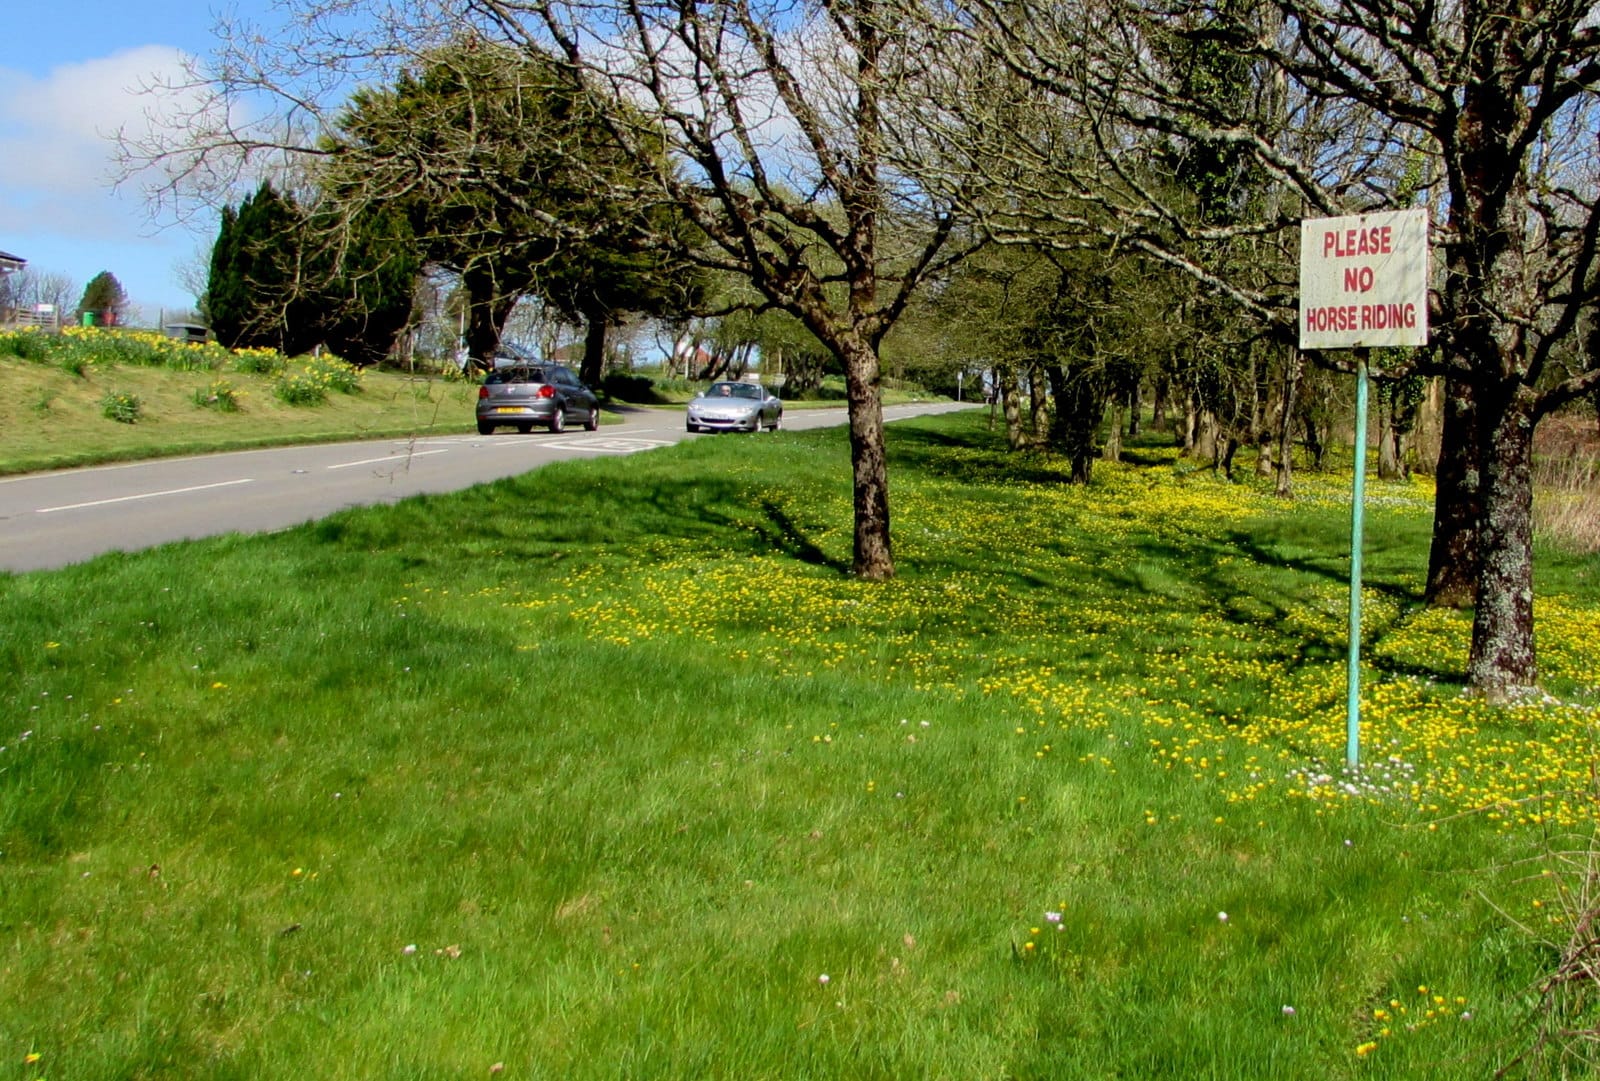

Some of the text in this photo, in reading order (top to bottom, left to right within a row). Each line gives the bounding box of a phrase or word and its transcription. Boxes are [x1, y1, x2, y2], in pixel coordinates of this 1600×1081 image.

[1323, 226, 1392, 258] PLEASE
[1344, 266, 1374, 292] NO
[1306, 303, 1416, 332] HORSE RIDING
